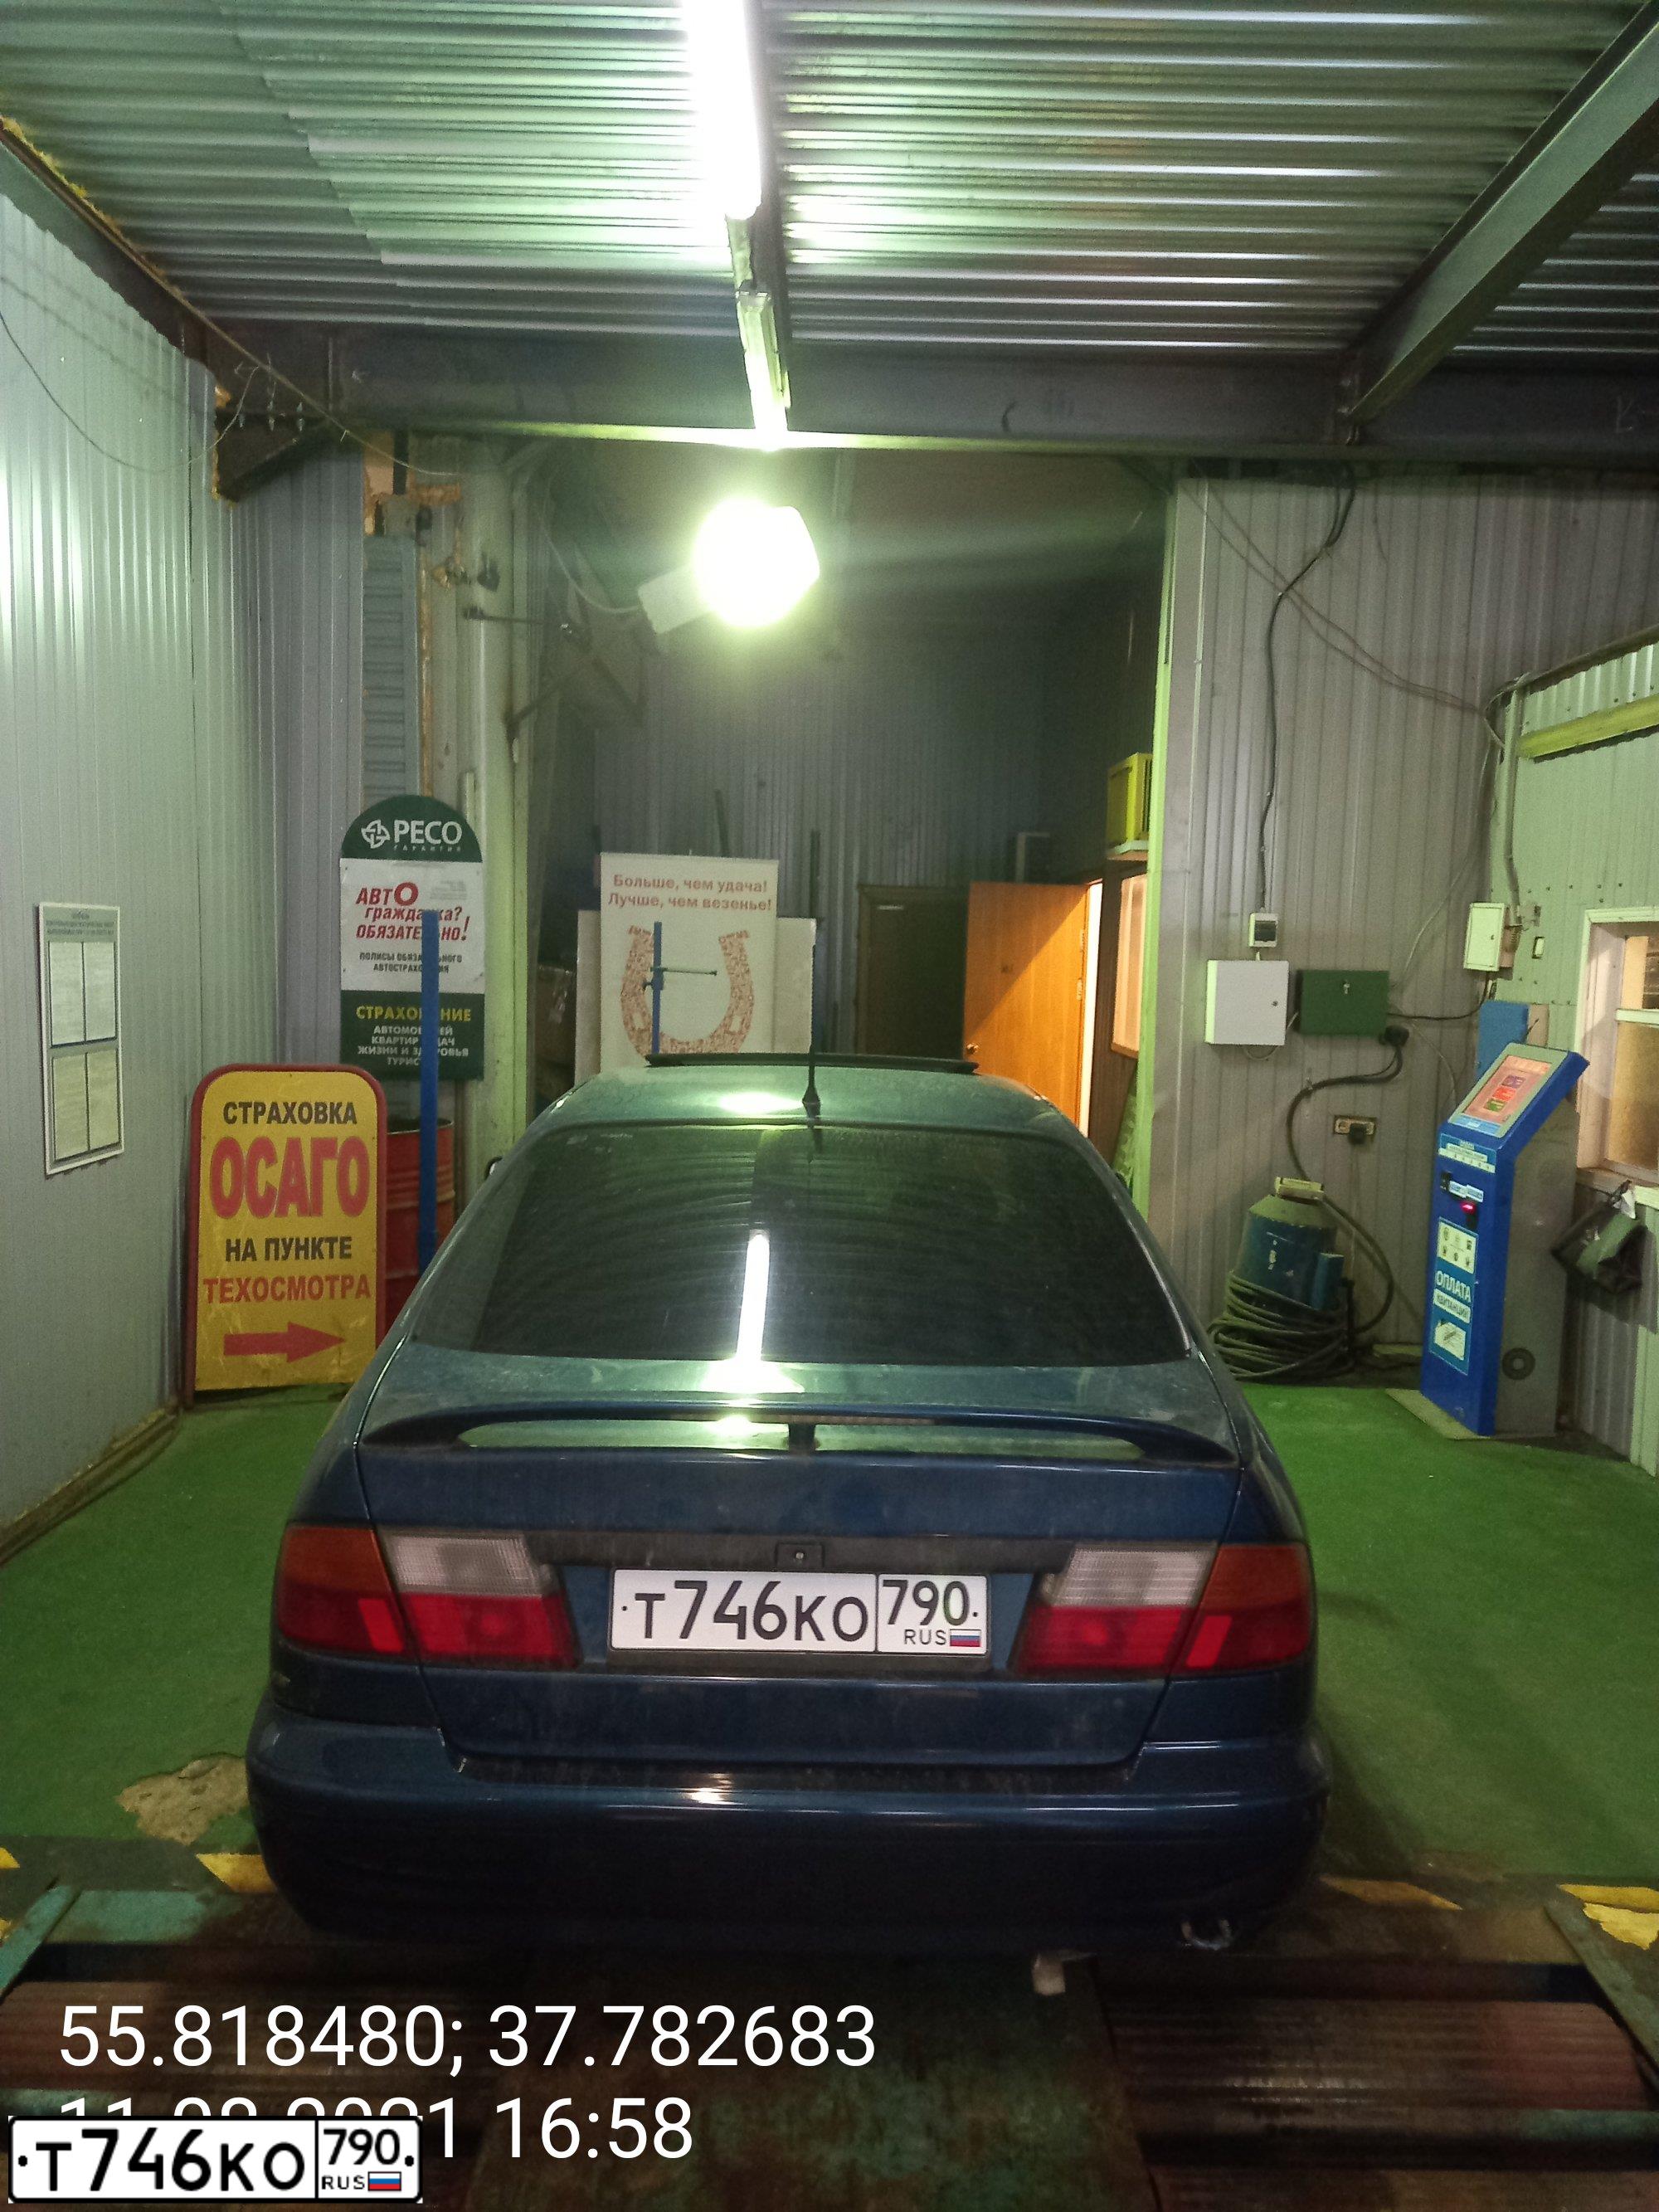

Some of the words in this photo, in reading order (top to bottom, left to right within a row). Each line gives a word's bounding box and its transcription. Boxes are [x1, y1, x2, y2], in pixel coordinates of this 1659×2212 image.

[393, 819, 463, 845] РЕСО
[355, 882, 419, 906] АВТО
[614, 874, 679, 890] Больше,
[684, 879, 713, 891] чем
[718, 879, 767, 894] удача!
[608, 893, 663, 909] Лучше,
[668, 896, 698, 909] чем
[702, 898, 771, 911] везенье!
[365, 906, 463, 923] граждаа?
[356, 916, 470, 942] ОБЯЗАТЕНО!
[359, 952, 395, 961] ПОЛИСЫ
[397, 953, 462, 963] ОБЯЗАНОГО
[373, 963, 450, 973] АВТОСТРАХОИЯ
[356, 1006, 471, 1022] СТРАХОНИЕ
[373, 1026, 453, 1035] АВТОМОЕЙ
[412, 1046, 469, 1057] ЗОВЬЯ
[223, 1101, 358, 1125] СТРАХОВКА
[209, 1136, 371, 1219] ОСАГО
[225, 1238, 258, 1262] НА
[264, 1236, 353, 1261] ПУНКТЕ
[203, 1274, 372, 1304] ТЕХОСМОТРА
[1436, 1270, 1472, 1303] ОПЛАТА
[883, 1579, 971, 1627] 790
[903, 1629, 946, 1646] RUS
